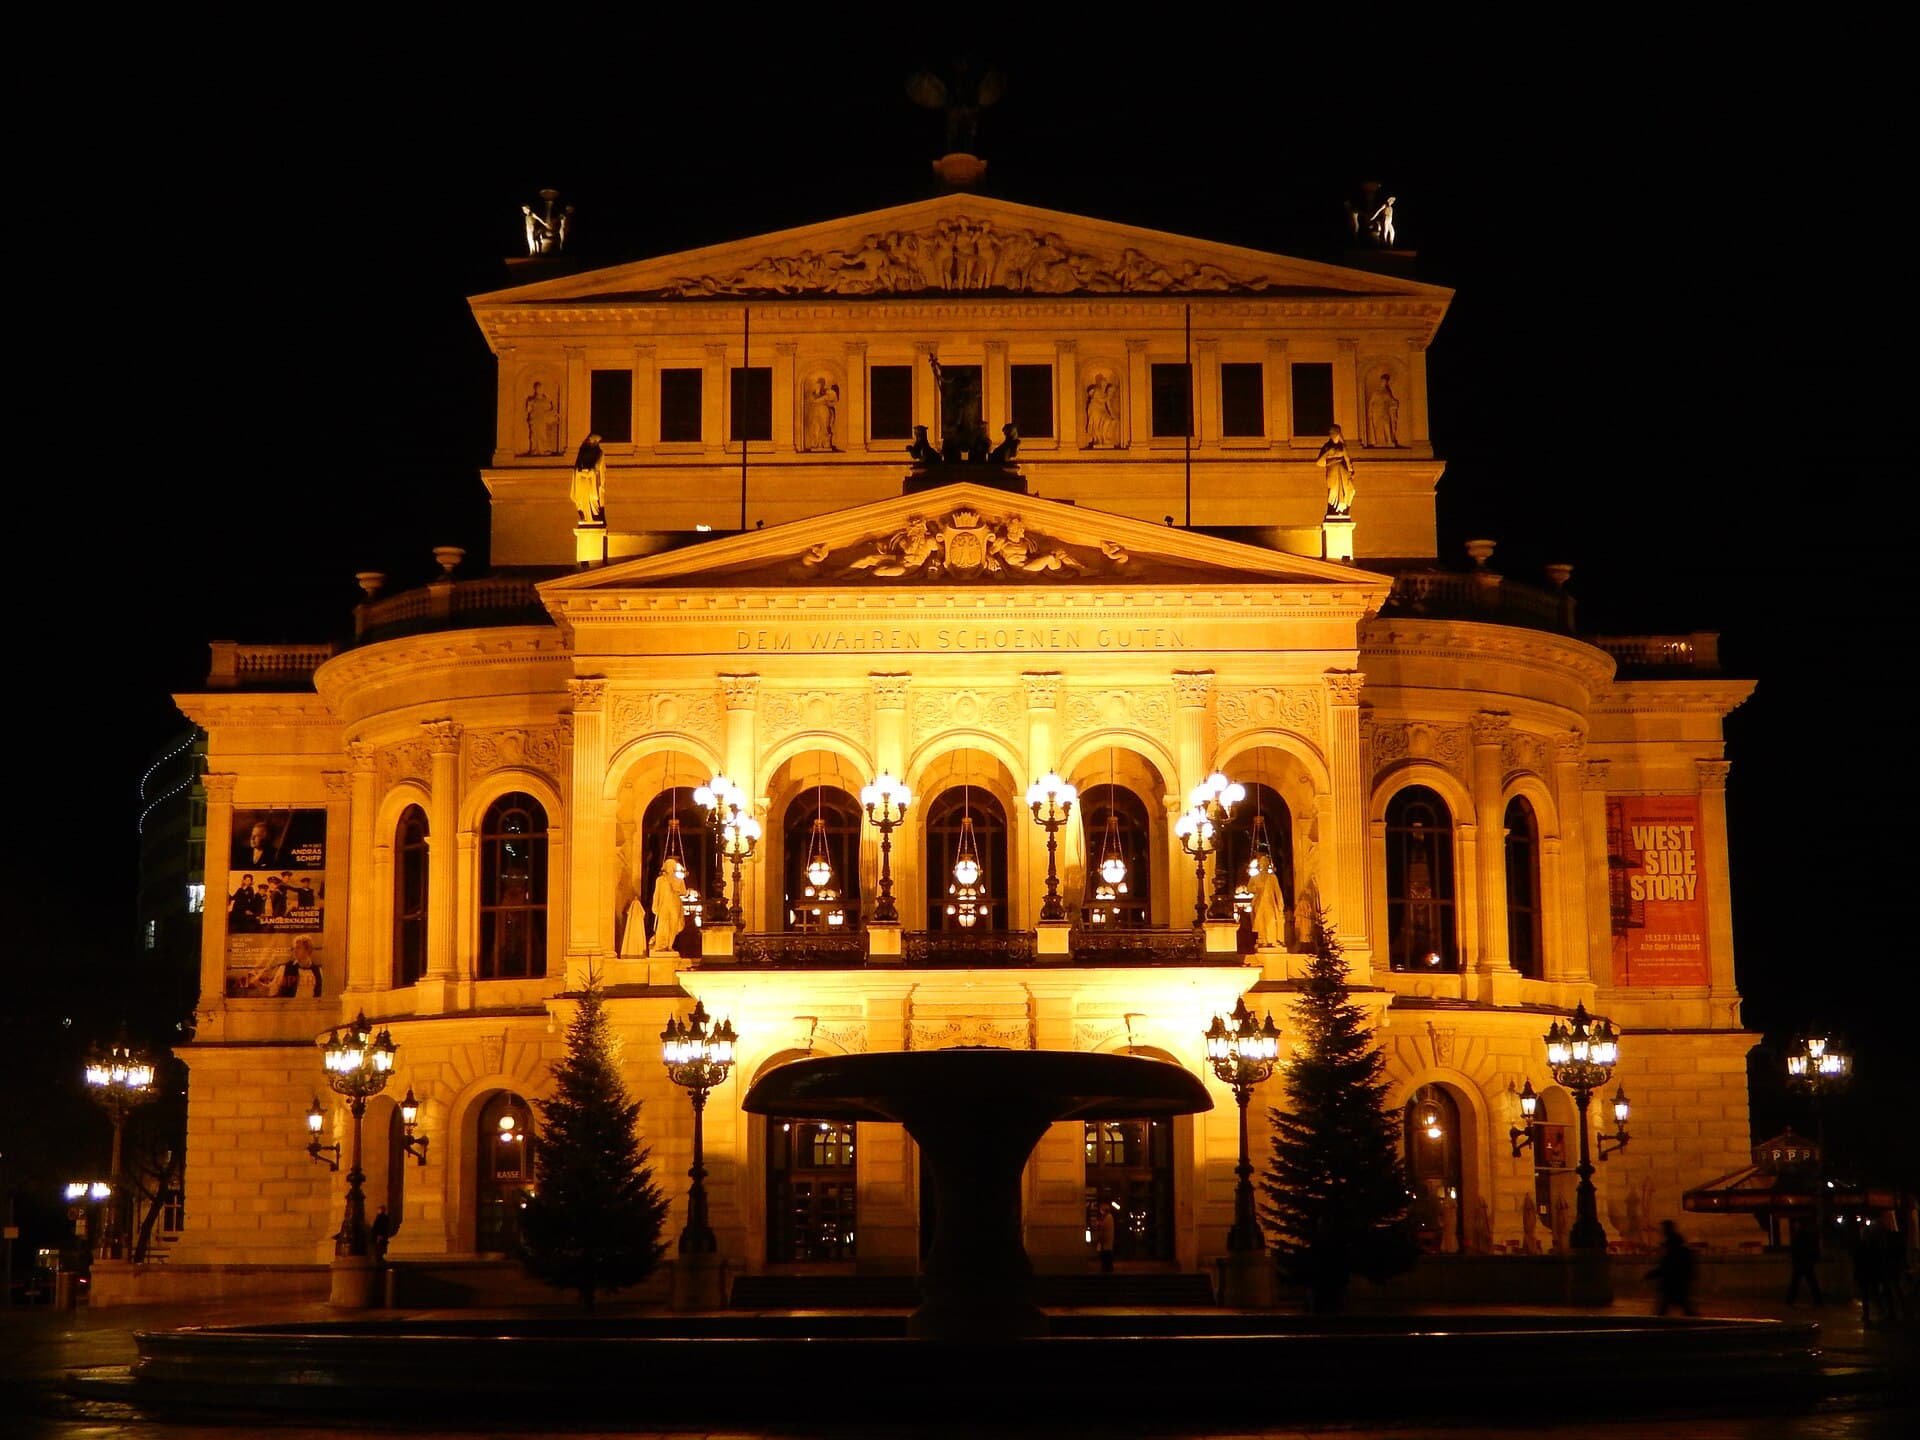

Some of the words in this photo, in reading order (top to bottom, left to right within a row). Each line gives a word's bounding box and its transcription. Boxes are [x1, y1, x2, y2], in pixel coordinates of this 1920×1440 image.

[737, 630, 791, 649] DEM
[806, 629, 921, 649] WAHREN
[937, 629, 1081, 648] SCHOENEN
[1632, 826, 1694, 850] WEST
[1645, 850, 1697, 875] SIDE
[1630, 874, 1697, 901] STORY
